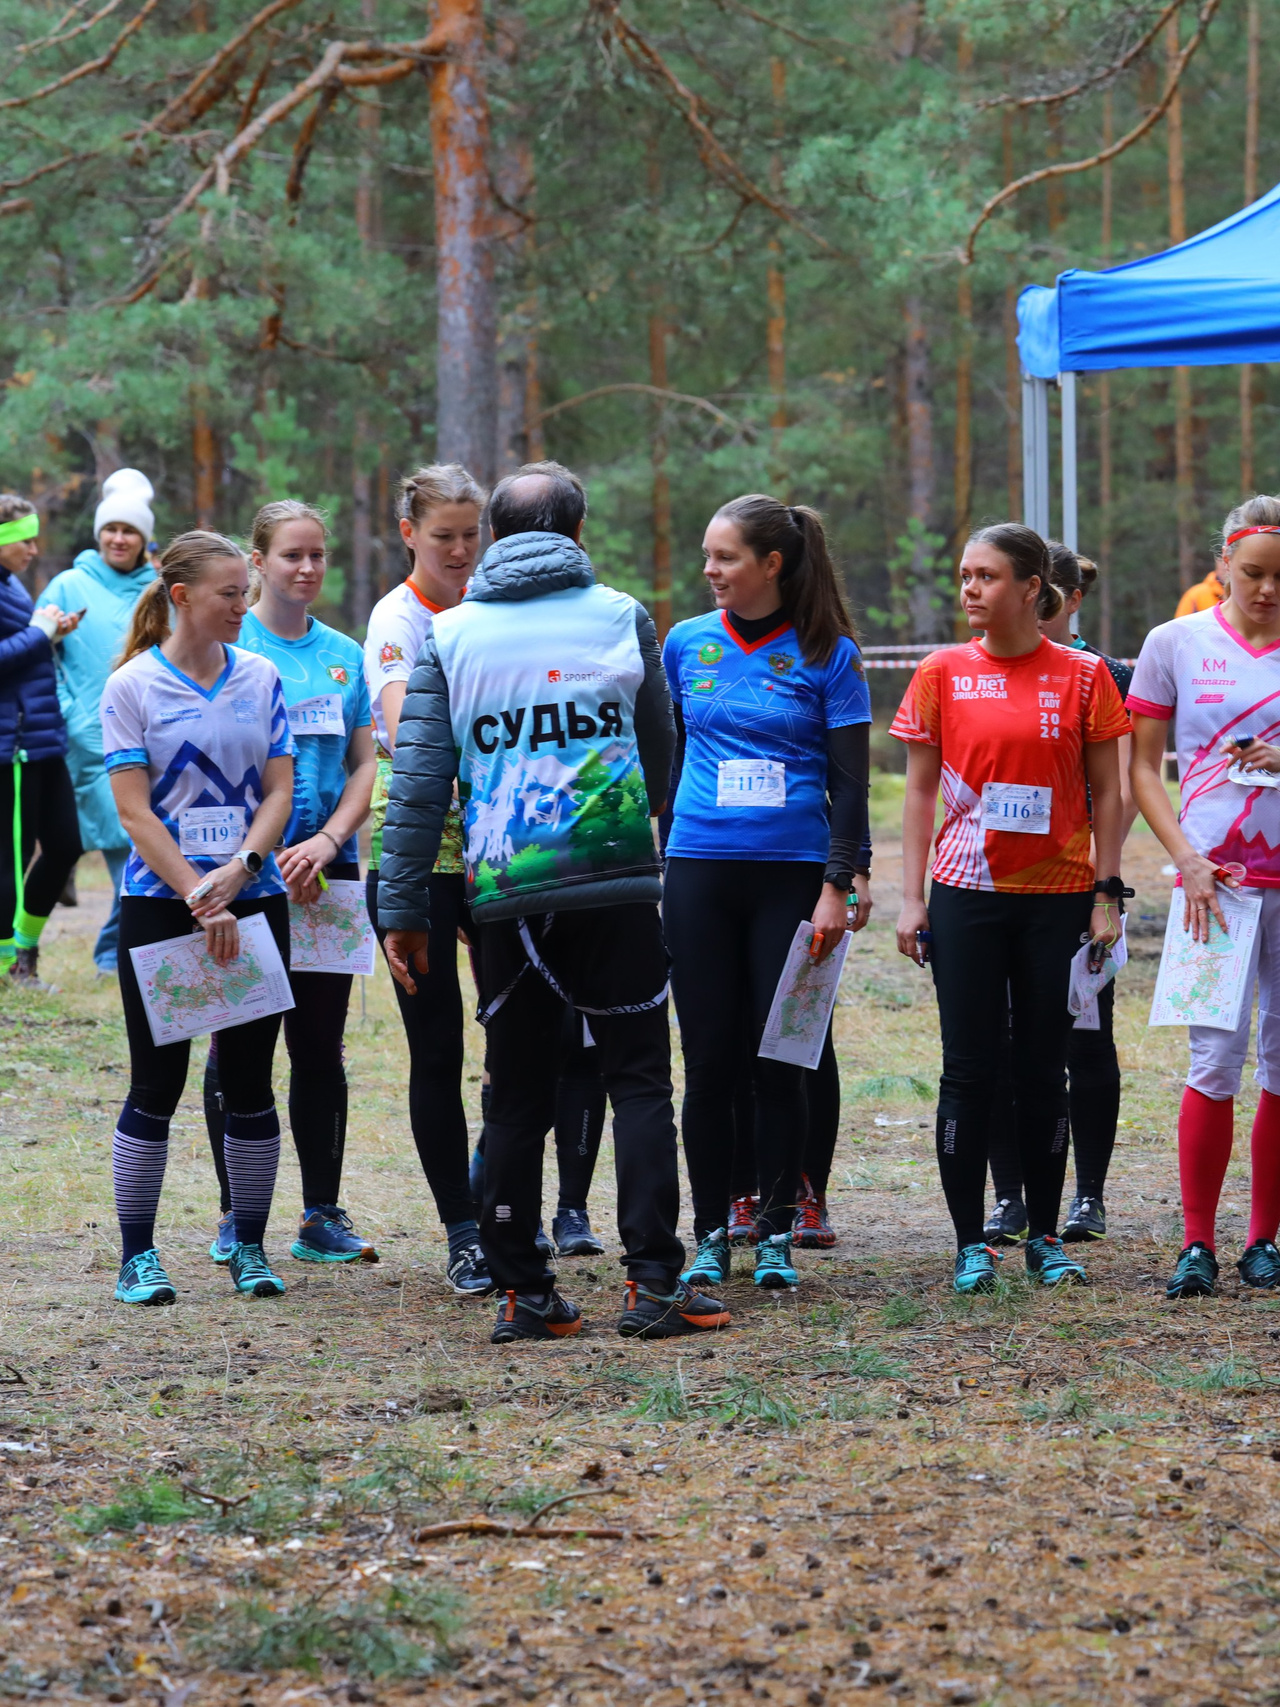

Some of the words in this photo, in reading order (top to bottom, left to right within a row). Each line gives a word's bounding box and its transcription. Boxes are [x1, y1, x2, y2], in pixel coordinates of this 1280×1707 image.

[951, 676, 973, 691] 10
[952, 690, 979, 701] SIRIUS
[980, 690, 1008, 699] SOCHI
[1039, 699, 1060, 708] LADY
[301, 710, 326, 723] 127
[1040, 712, 1060, 725] 20
[473, 701, 623, 755] СУДЬЯ
[1040, 726, 1060, 739] 24
[739, 776, 765, 791] 117
[1003, 802, 1031, 818] 116
[201, 826, 229, 842] 119
